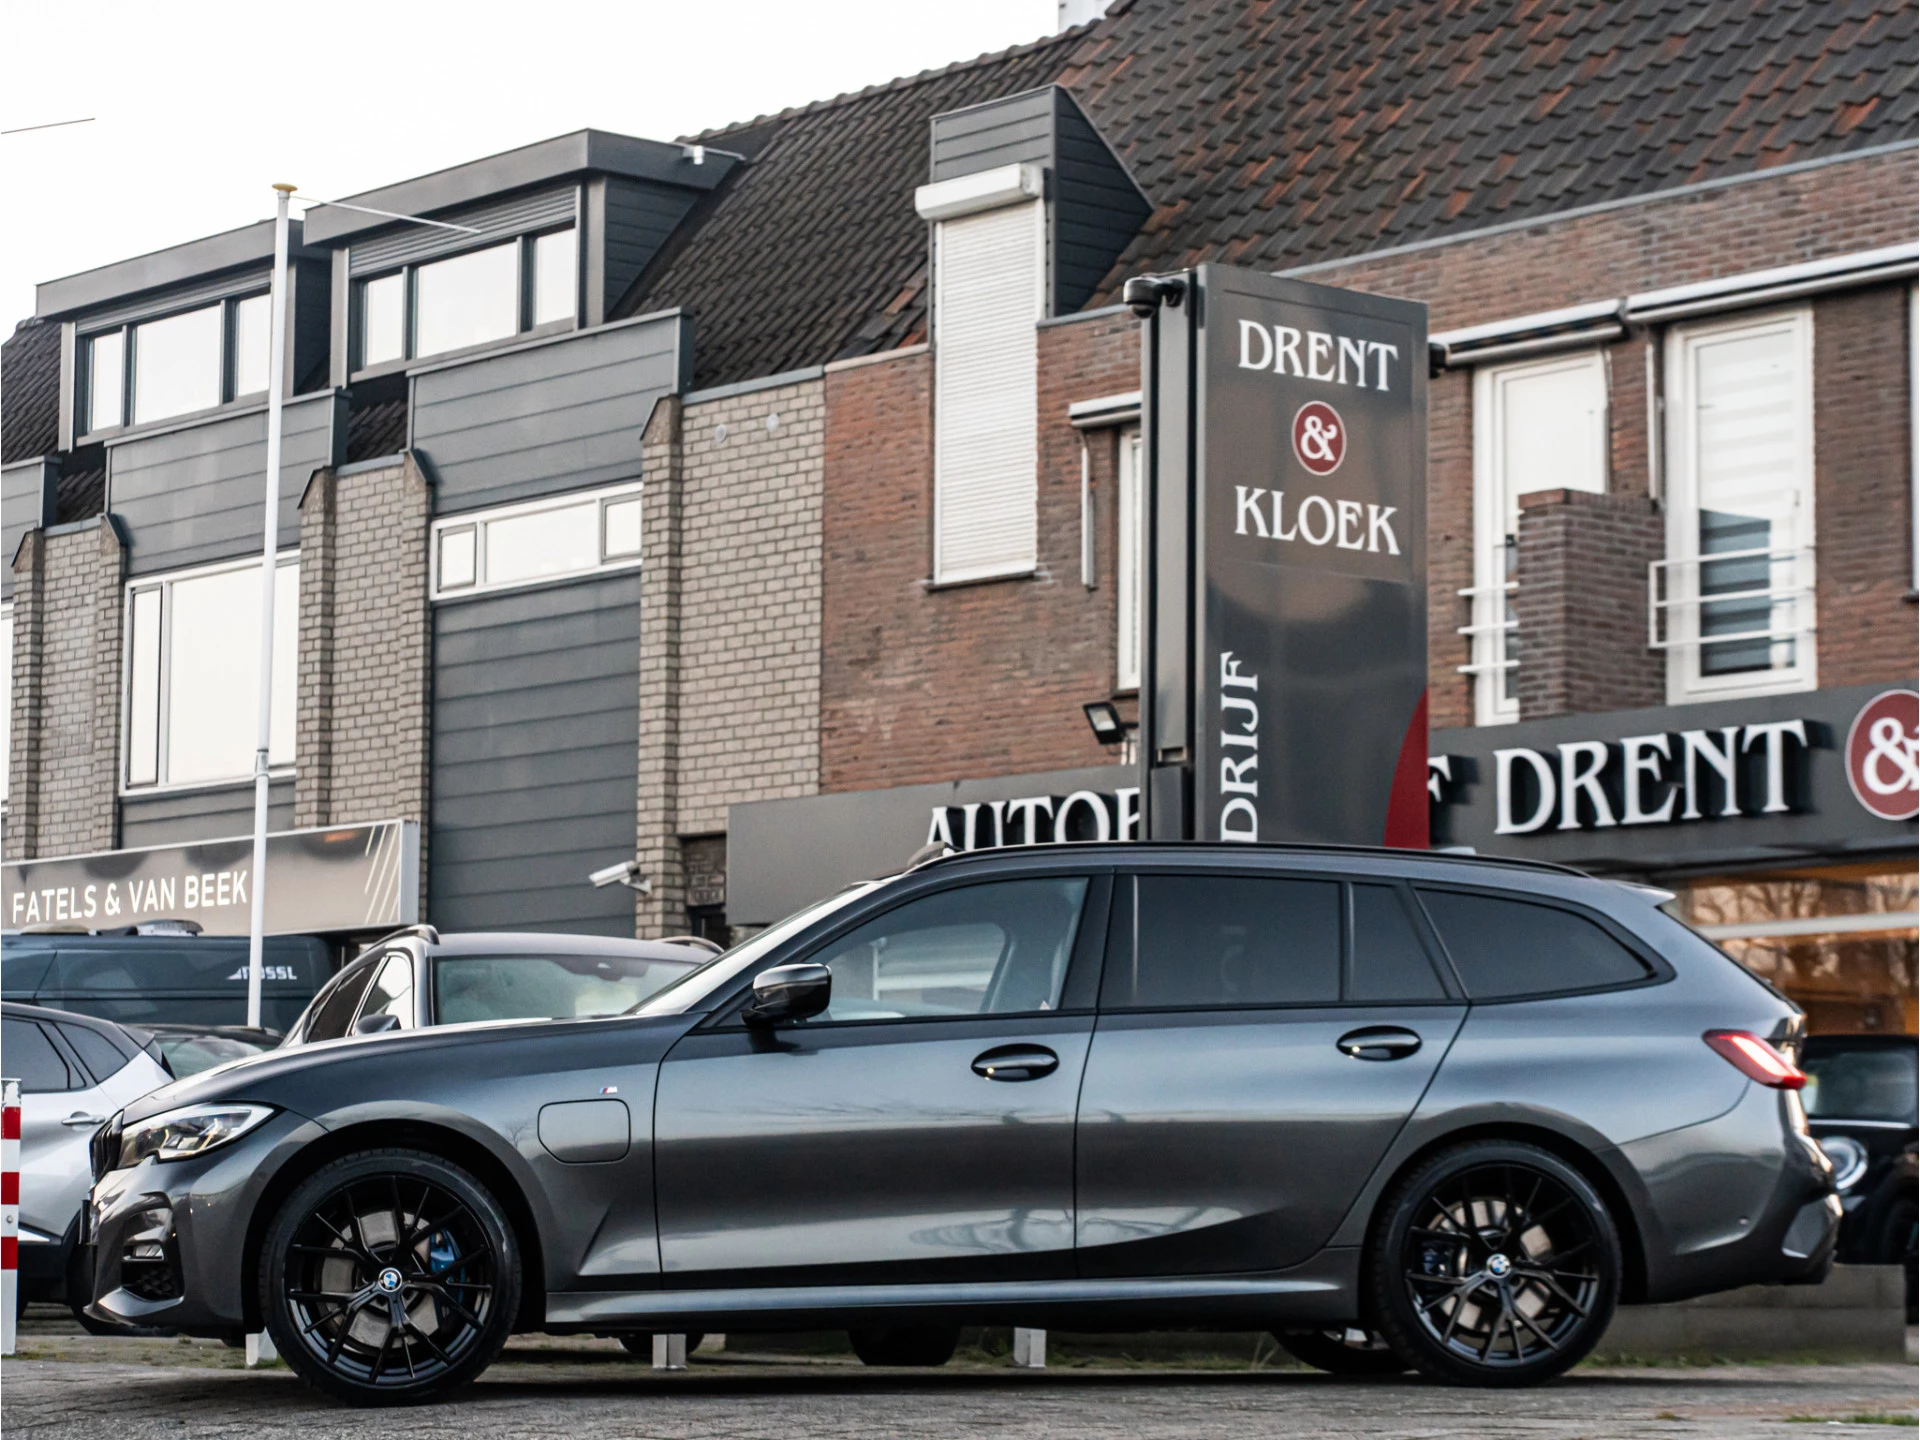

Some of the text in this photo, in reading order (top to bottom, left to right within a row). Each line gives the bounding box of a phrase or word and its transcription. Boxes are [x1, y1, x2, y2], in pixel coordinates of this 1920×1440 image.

[1238, 319, 1398, 391] DRENT
[1301, 415, 1338, 461] &
[1235, 485, 1401, 555] KLOEK
[1494, 719, 1808, 835] DRENT
[1862, 717, 1919, 795] &
[12, 869, 247, 924] FATELS & VAN BEEK
